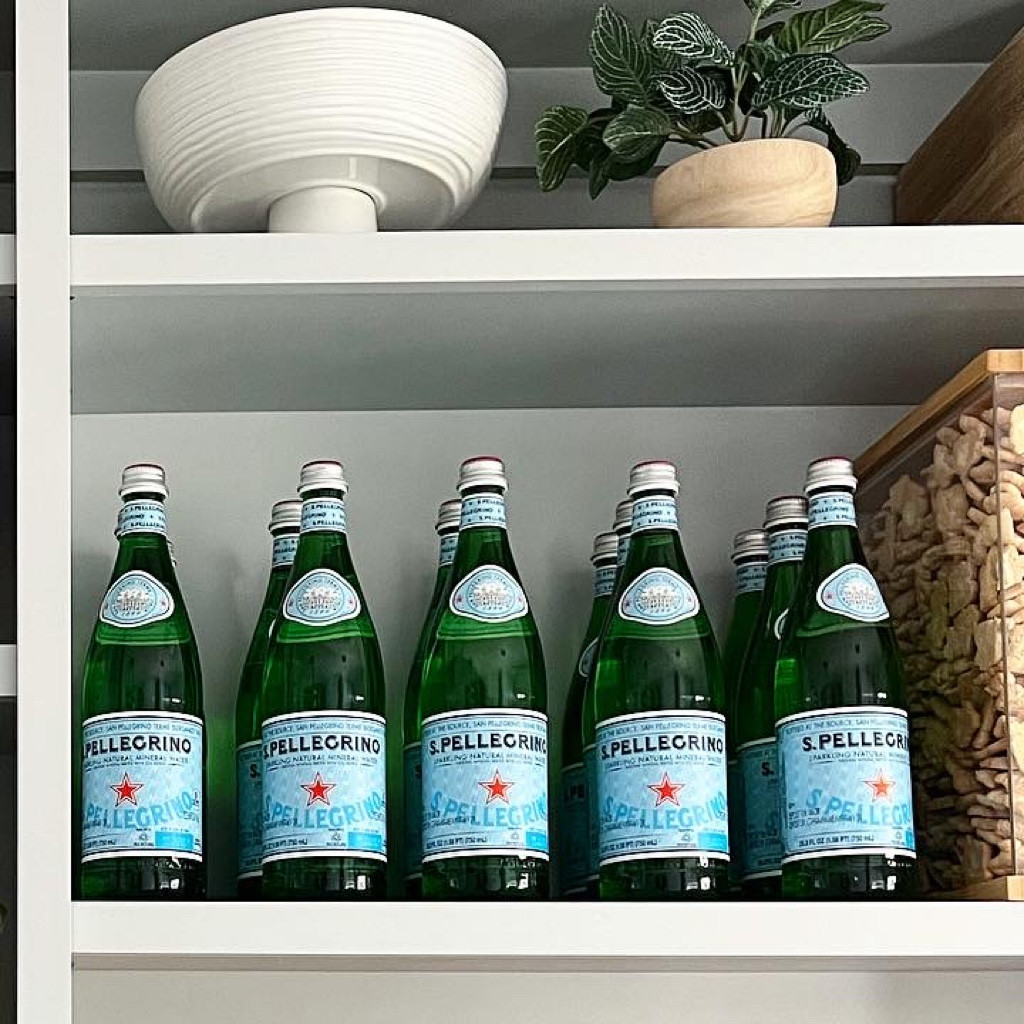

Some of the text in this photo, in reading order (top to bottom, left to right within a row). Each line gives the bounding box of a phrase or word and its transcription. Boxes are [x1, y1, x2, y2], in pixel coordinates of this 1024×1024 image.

[85, 734, 192, 758] PELLEGRINO
[263, 734, 381, 760] S.PELLEGRINO
[601, 734, 723, 760] S.PELLEGRINO
[802, 731, 909, 752] S.PELLEGRI
[87, 790, 194, 829] PELLEGRINO
